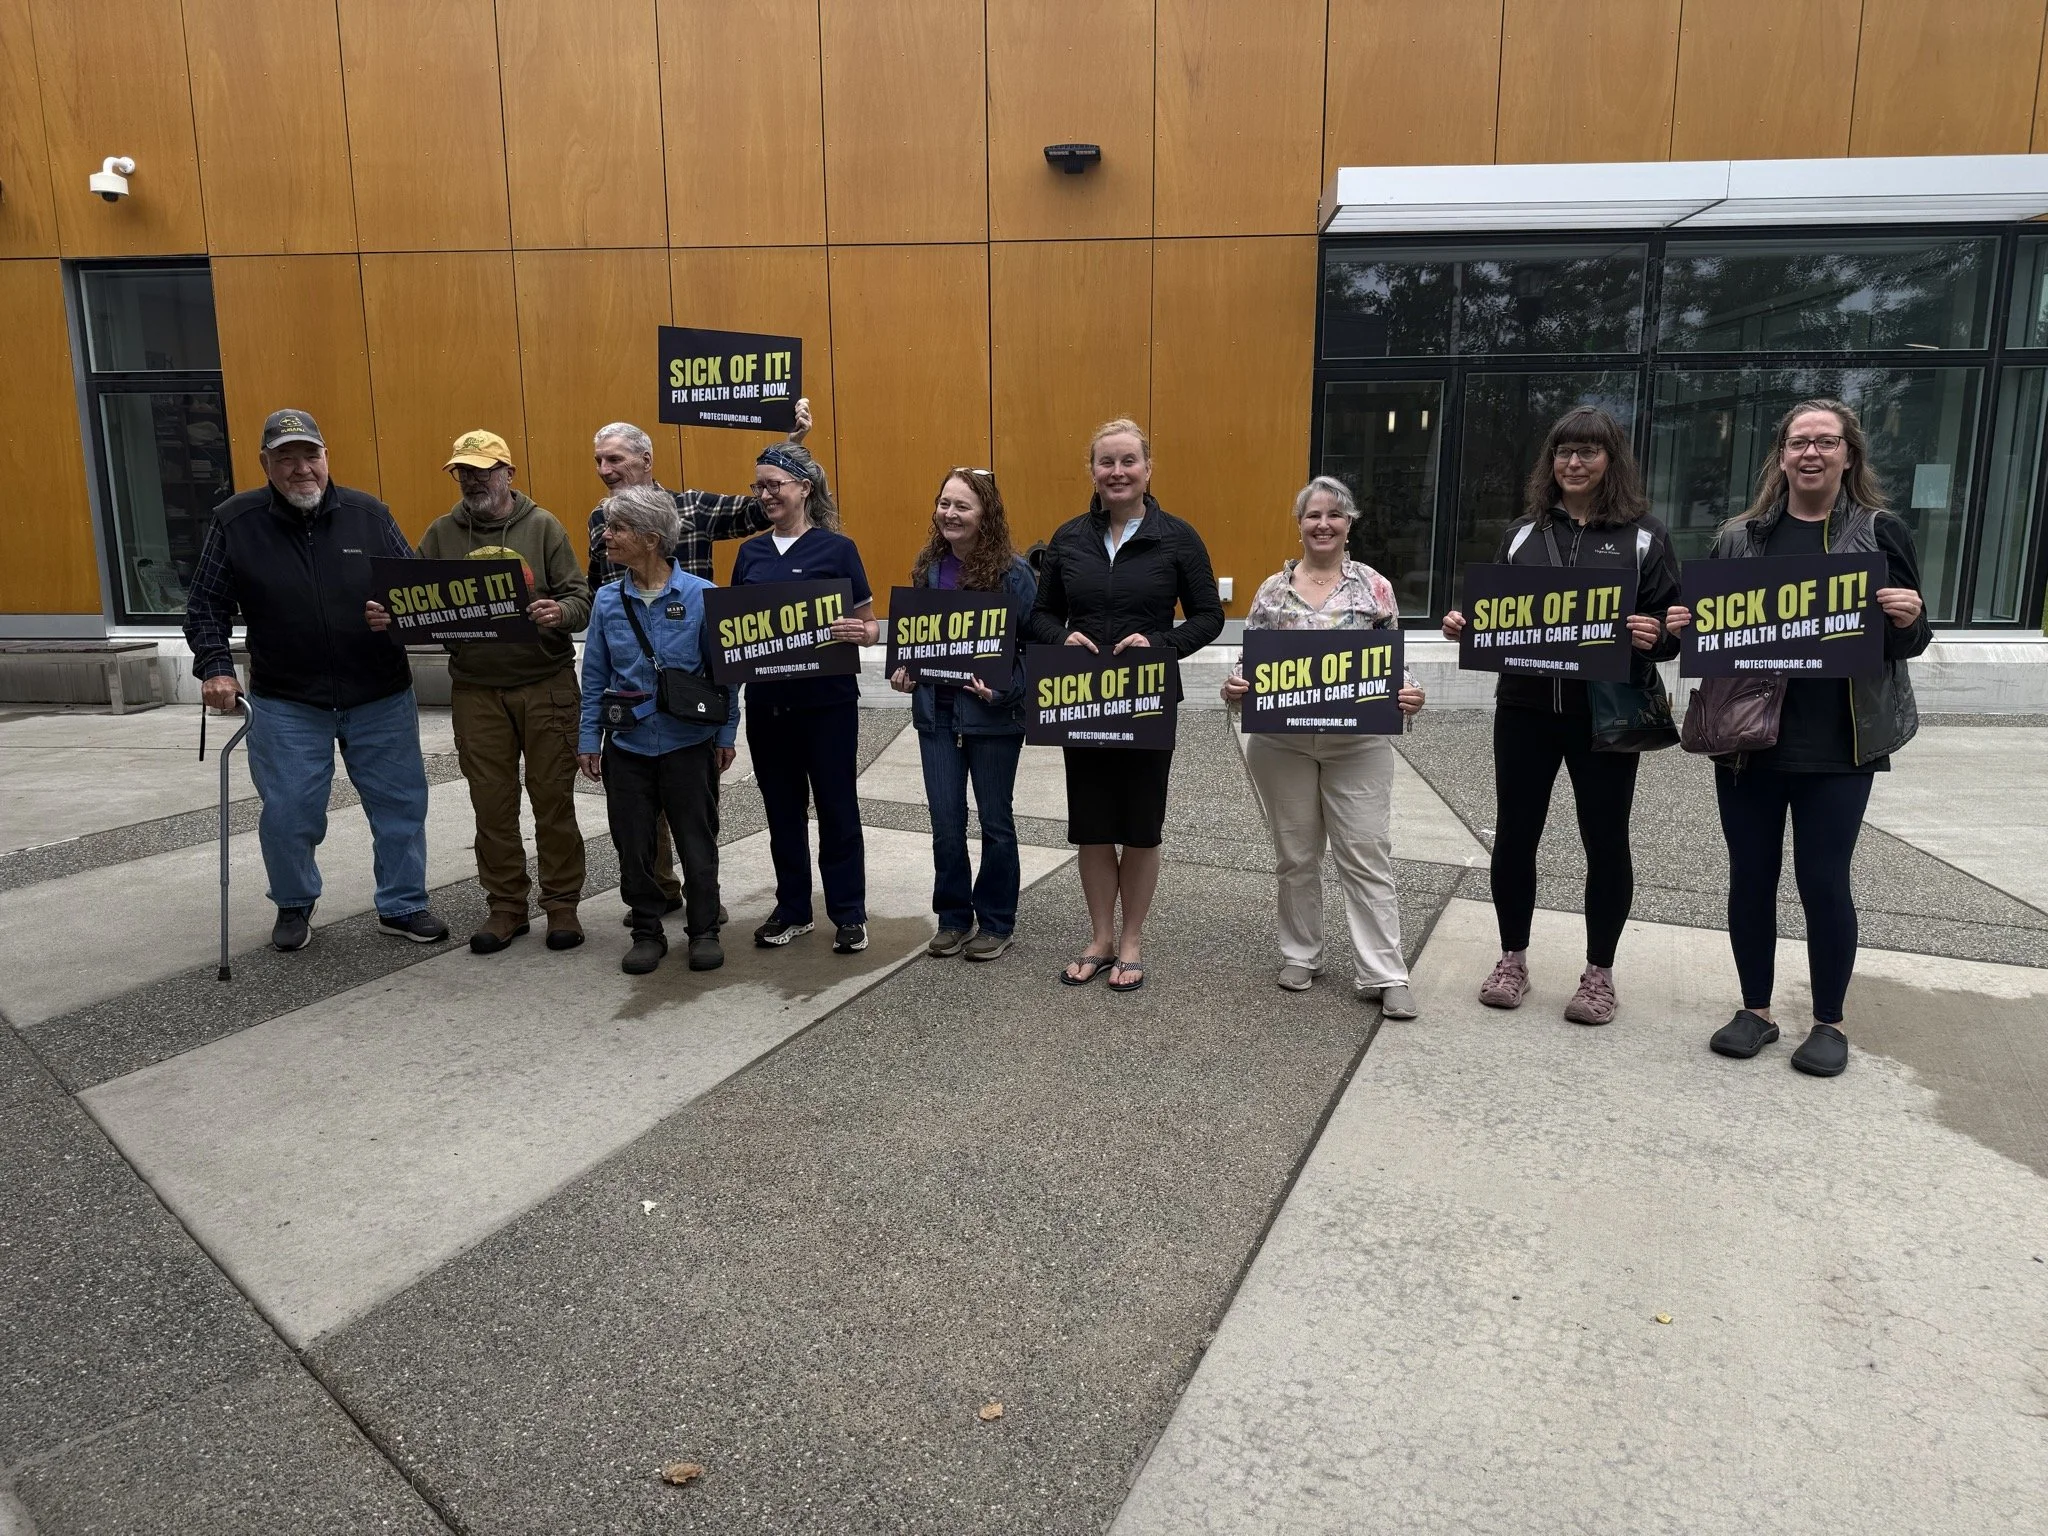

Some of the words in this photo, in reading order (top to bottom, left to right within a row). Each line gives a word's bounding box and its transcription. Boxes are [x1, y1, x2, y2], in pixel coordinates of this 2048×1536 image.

[670, 356, 722, 387] SICK
[730, 354, 757, 383] OF
[765, 352, 791, 380] IT!
[672, 390, 688, 403] FIX
[692, 387, 729, 402] HEALTH
[733, 385, 759, 398] CARE
[763, 382, 789, 396] NOW.
[700, 412, 761, 423] PROTECTOURCARE.ORG
[389, 583, 445, 615] SICK
[449, 578, 477, 606] OF
[484, 573, 517, 601] IT!
[1474, 595, 1534, 631] SICK
[1543, 590, 1578, 624] OF
[1586, 586, 1621, 621] IT!
[1696, 588, 1767, 633] SICK
[1777, 580, 1816, 620] OF
[1828, 571, 1868, 612] IT!
[397, 614, 416, 628] FIX
[418, 610, 457, 626] HEALTH
[460, 605, 488, 619] CARE
[491, 601, 519, 615] NOW.
[719, 610, 774, 648] SICK
[780, 601, 808, 633] OF
[815, 594, 843, 626] IT!
[897, 614, 942, 645] SICK
[948, 611, 974, 640] OF
[980, 608, 1007, 637] IT!
[724, 648, 741, 664] FIX
[744, 639, 782, 659] HEALTH
[787, 632, 814, 649] CARE
[816, 628, 835, 641] NO
[1474, 633, 1491, 648] FIX
[1496, 629, 1541, 646] HEALTH
[1545, 626, 1578, 642] CARE
[1582, 623, 1616, 640] NOW.
[1698, 634, 1719, 652] FIX
[1724, 625, 1776, 648] HEALTH
[1781, 619, 1819, 640] CARE
[1824, 612, 1865, 633] NOW.
[898, 647, 912, 660] FIX
[915, 643, 946, 658] HEALTH
[950, 641, 973, 655] CARE
[977, 639, 1002, 653] NOW.
[1505, 657, 1579, 670] PROTECTOURCARE.ORG
[1735, 660, 1822, 669] PROTECTOURCARE.ORG
[755, 663, 819, 675] PROTECTOURCARE.ORG
[1255, 657, 1313, 694] SICK
[1322, 651, 1353, 685] OF
[1362, 645, 1392, 679] IT!
[1038, 672, 1092, 708] SICK
[1101, 667, 1130, 699] OF
[1138, 663, 1165, 694] IT!
[1257, 695, 1274, 711] FIX
[1278, 689, 1320, 708] HEALTH
[1324, 684, 1354, 701] CARE
[1358, 679, 1390, 697] NOW.
[1040, 709, 1056, 724] FIX
[1060, 704, 1100, 721] HEALTH
[1104, 699, 1131, 715] CARE
[1135, 696, 1163, 712] NOW.
[1287, 718, 1357, 726] PROTECTOURCARE.ORG
[1068, 732, 1134, 740] PROTECTOURCARE.ORG
